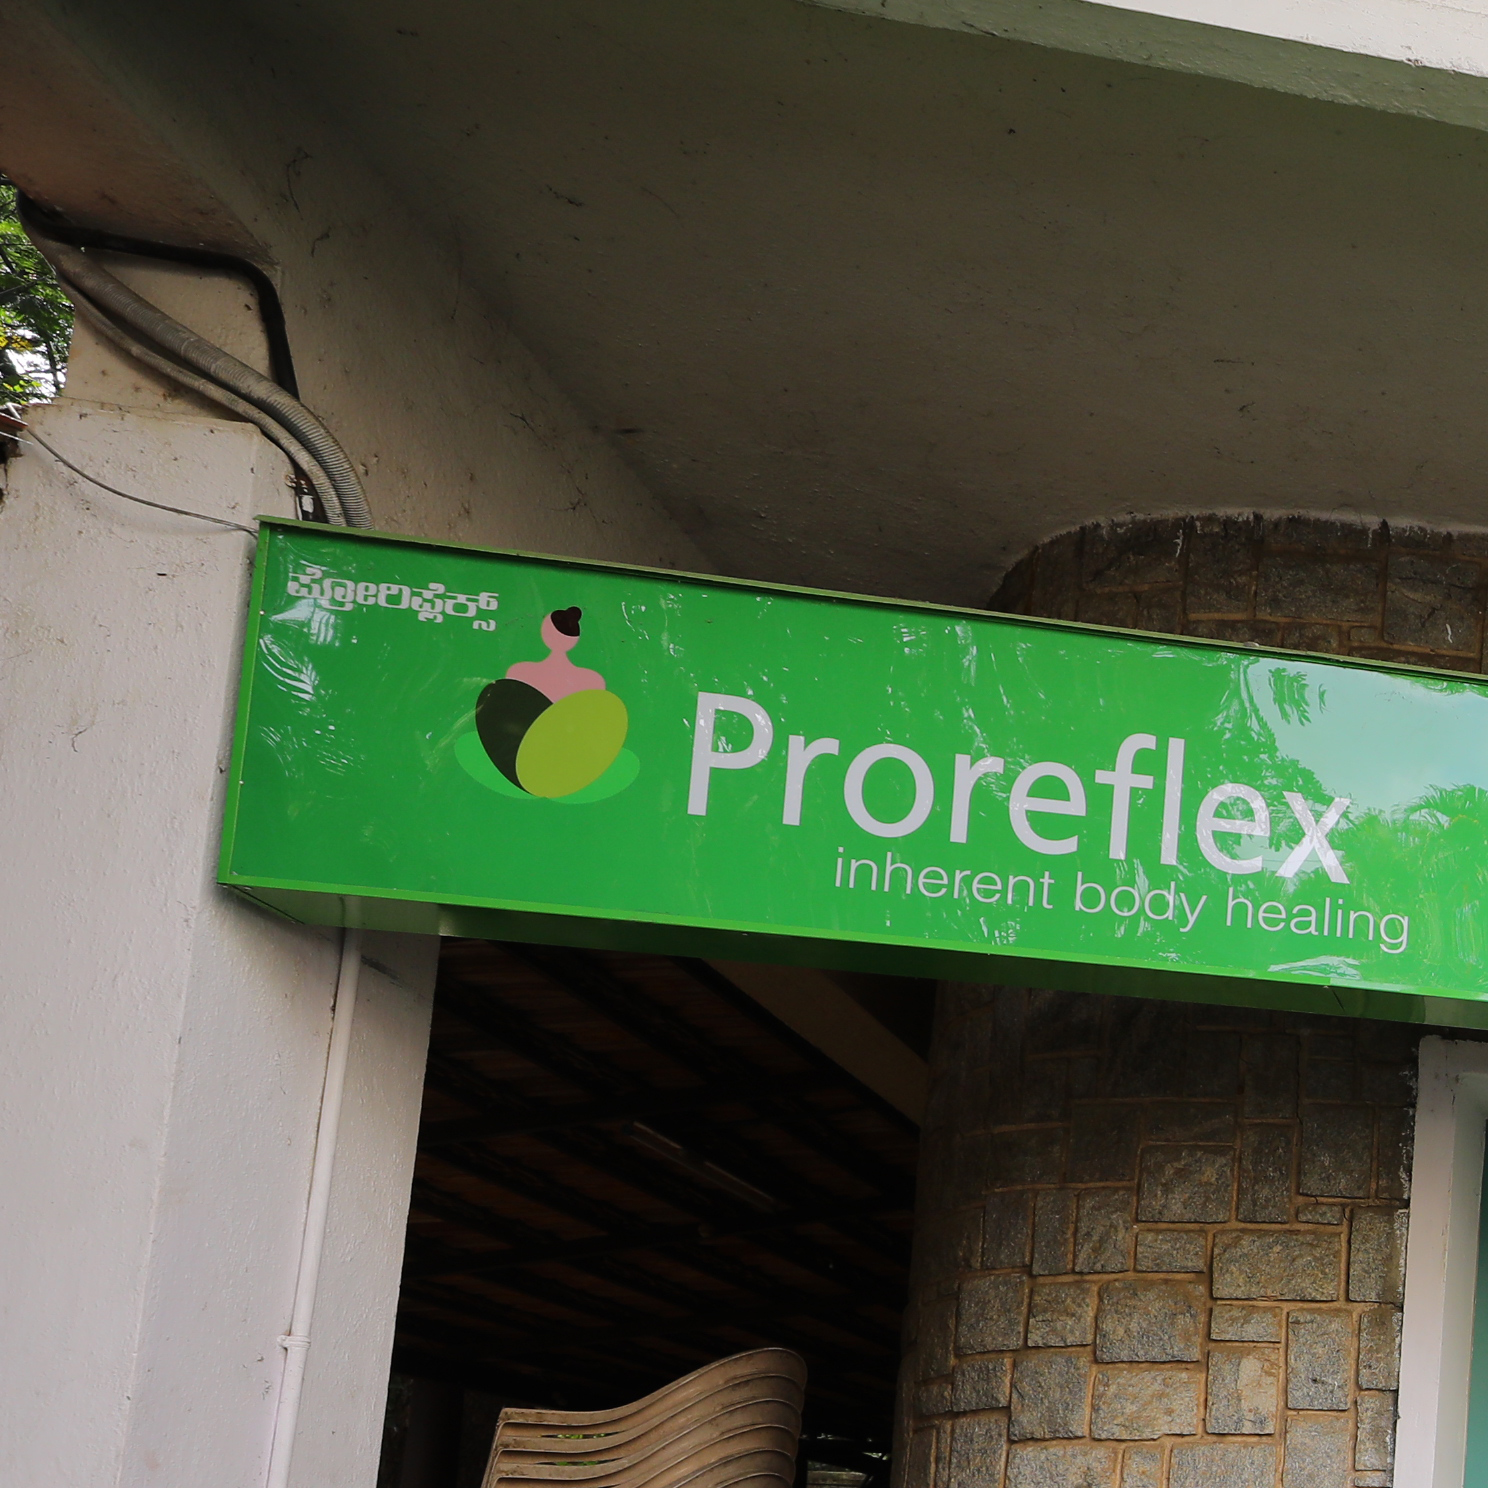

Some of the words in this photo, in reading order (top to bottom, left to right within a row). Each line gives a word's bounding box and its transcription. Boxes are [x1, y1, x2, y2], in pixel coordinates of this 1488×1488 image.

[687, 691, 1351, 884] Proreflex
[835, 847, 1054, 909] inherent
[1075, 871, 1207, 932] body
[1226, 887, 1410, 955] healing
